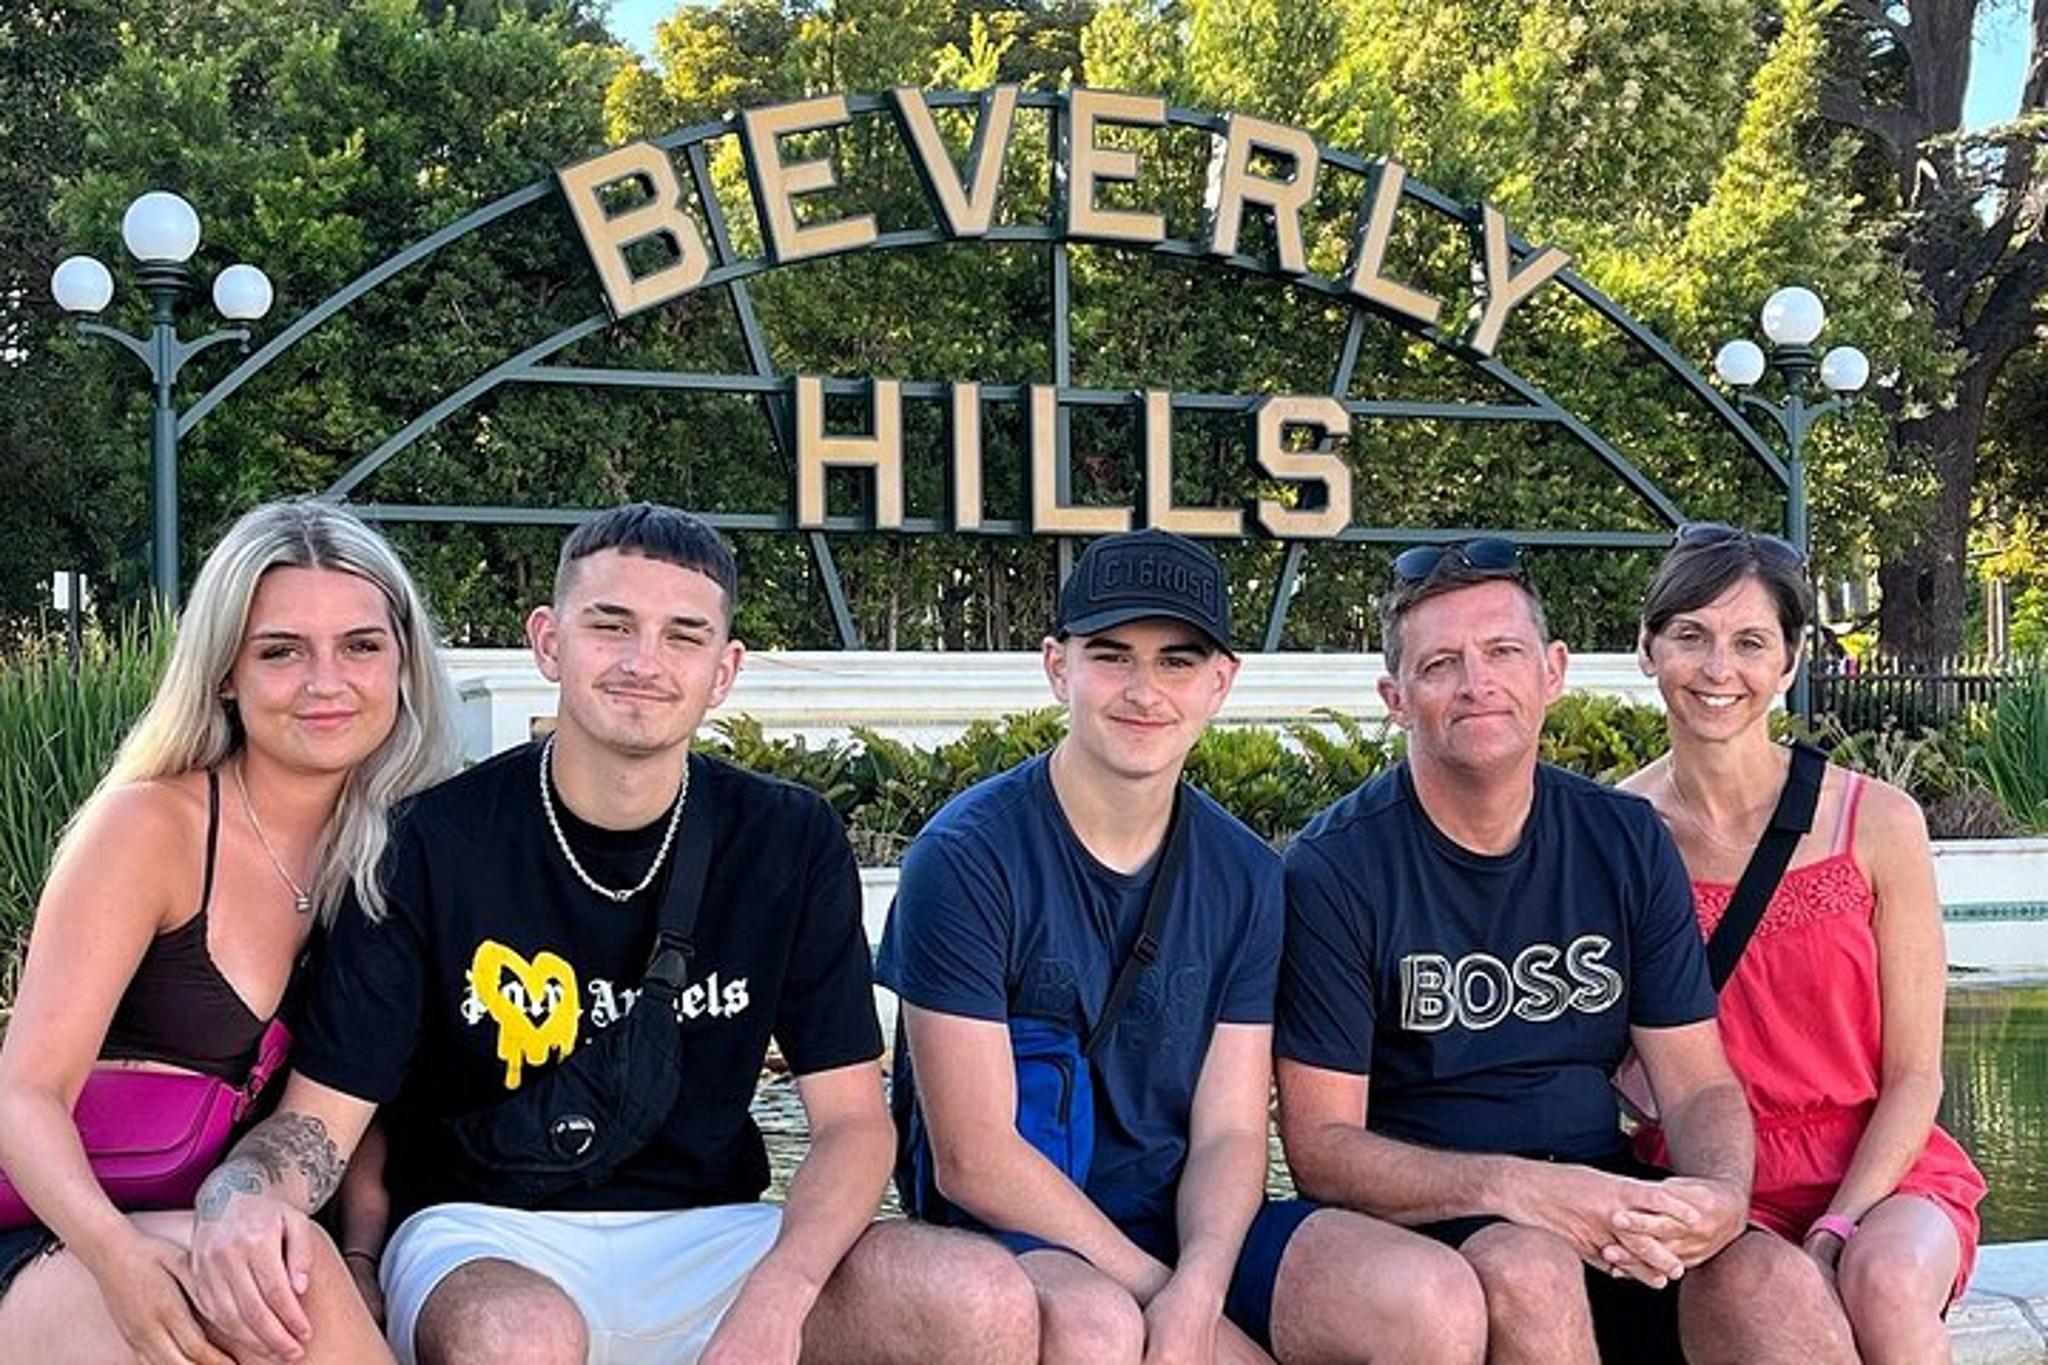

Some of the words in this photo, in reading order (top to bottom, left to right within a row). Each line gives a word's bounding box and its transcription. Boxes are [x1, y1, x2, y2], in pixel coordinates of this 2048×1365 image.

[557, 84, 1571, 357] BEVERLY
[796, 376, 1352, 538] HILLS
[1400, 934, 1622, 1031] BOSS
